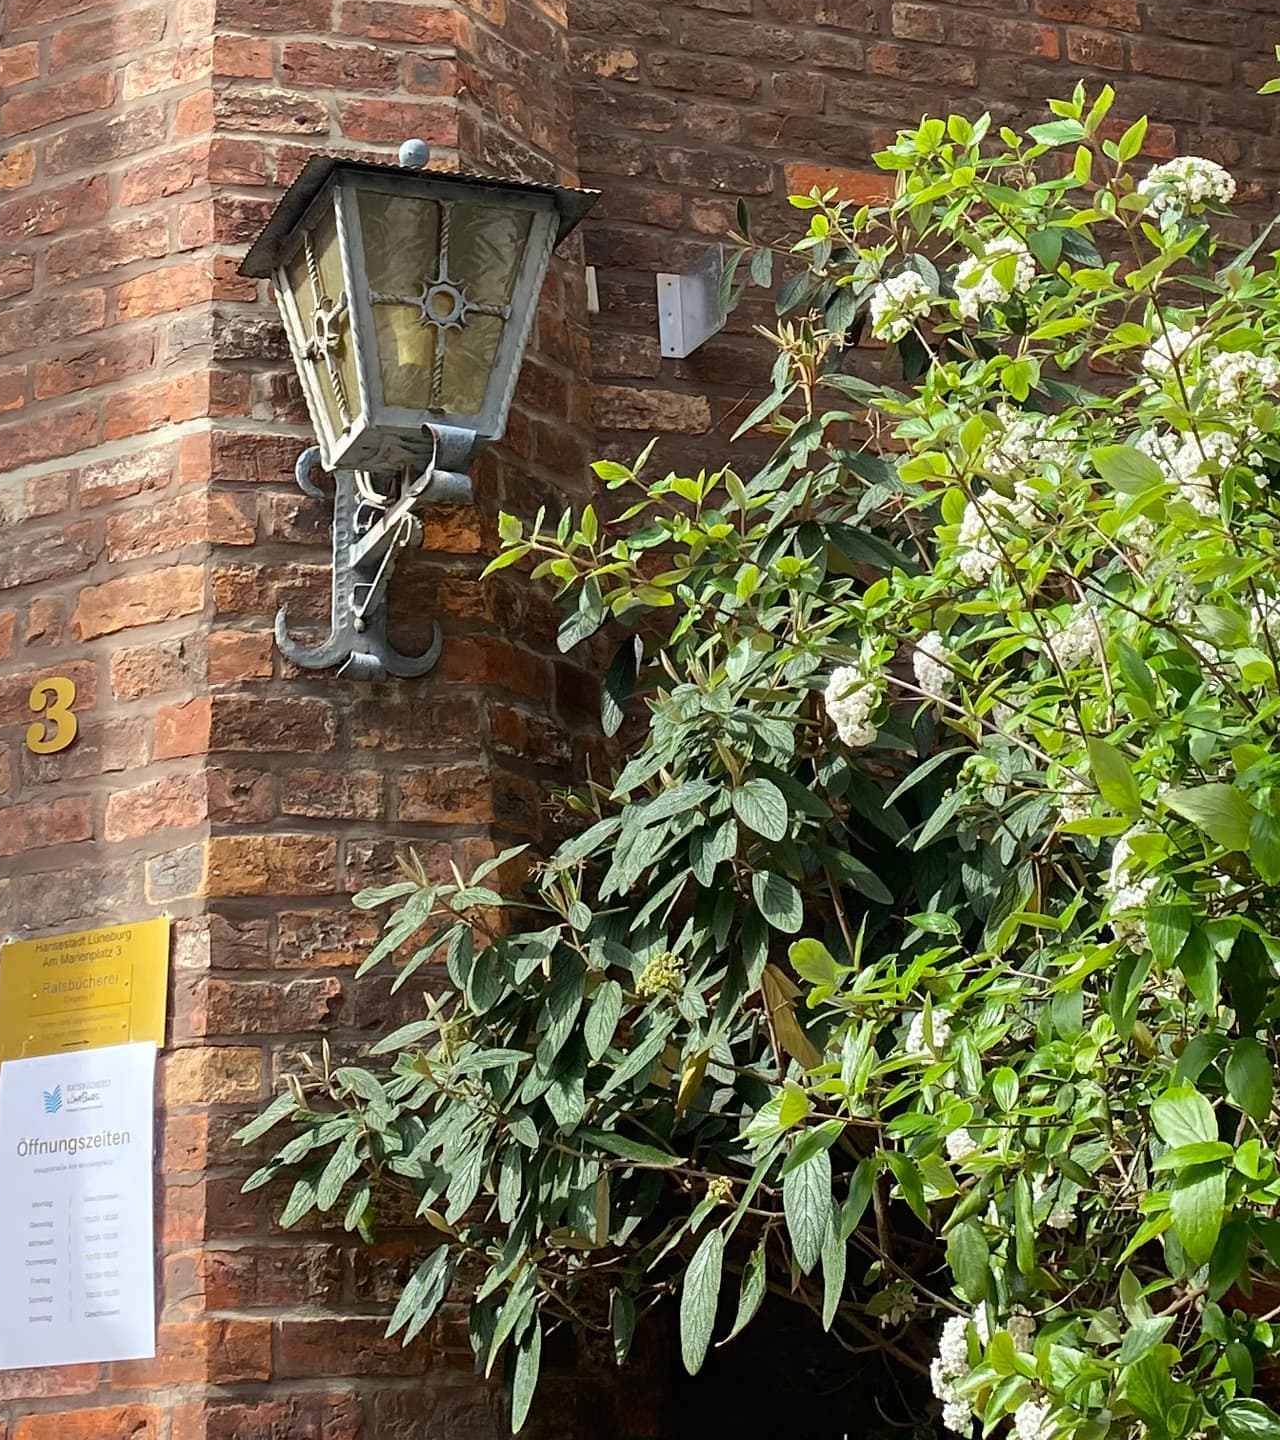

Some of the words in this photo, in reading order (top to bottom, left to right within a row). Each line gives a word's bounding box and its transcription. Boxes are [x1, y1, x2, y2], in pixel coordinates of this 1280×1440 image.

[26, 676, 78, 755] 3
[35, 937, 86, 953] Hansestadt
[88, 930, 132, 946] Lüneburg
[42, 956, 58, 968] Am
[60, 948, 114, 965] Marienplatz
[115, 945, 122, 957] 3
[42, 974, 120, 994] Ratsbücherei
[17, 1130, 130, 1157] Öffnungszeiten
